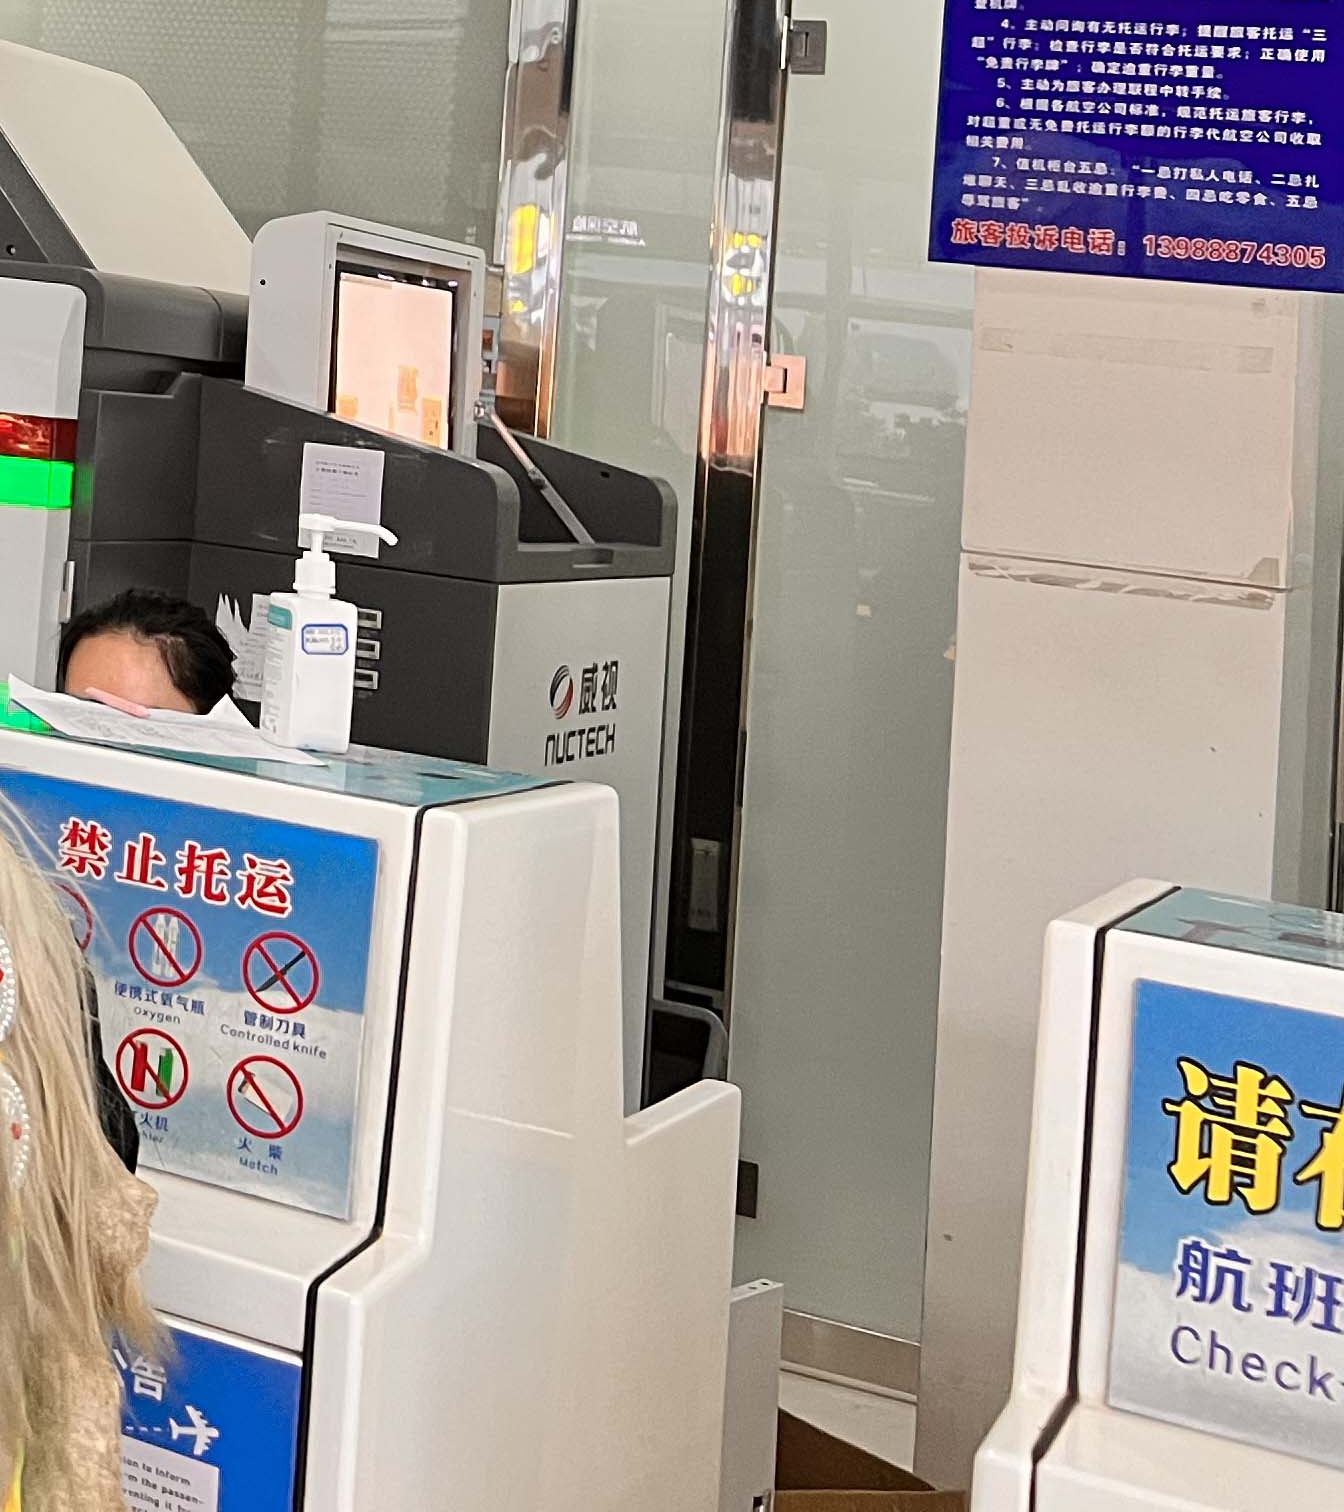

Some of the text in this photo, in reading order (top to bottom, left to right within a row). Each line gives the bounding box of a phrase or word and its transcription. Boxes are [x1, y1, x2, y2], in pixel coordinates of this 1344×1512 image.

[578, 660, 619, 715] 威视
[544, 723, 616, 766] NUCTECH
[59, 817, 293, 918] 禁止托运
[114, 981, 206, 1016] 便携式氧气瓶
[220, 1023, 327, 1059] Controlled knife
[243, 1009, 306, 1040] 管制刀具
[132, 1110, 169, 1133] 火机
[237, 1136, 284, 1161] 火柴
